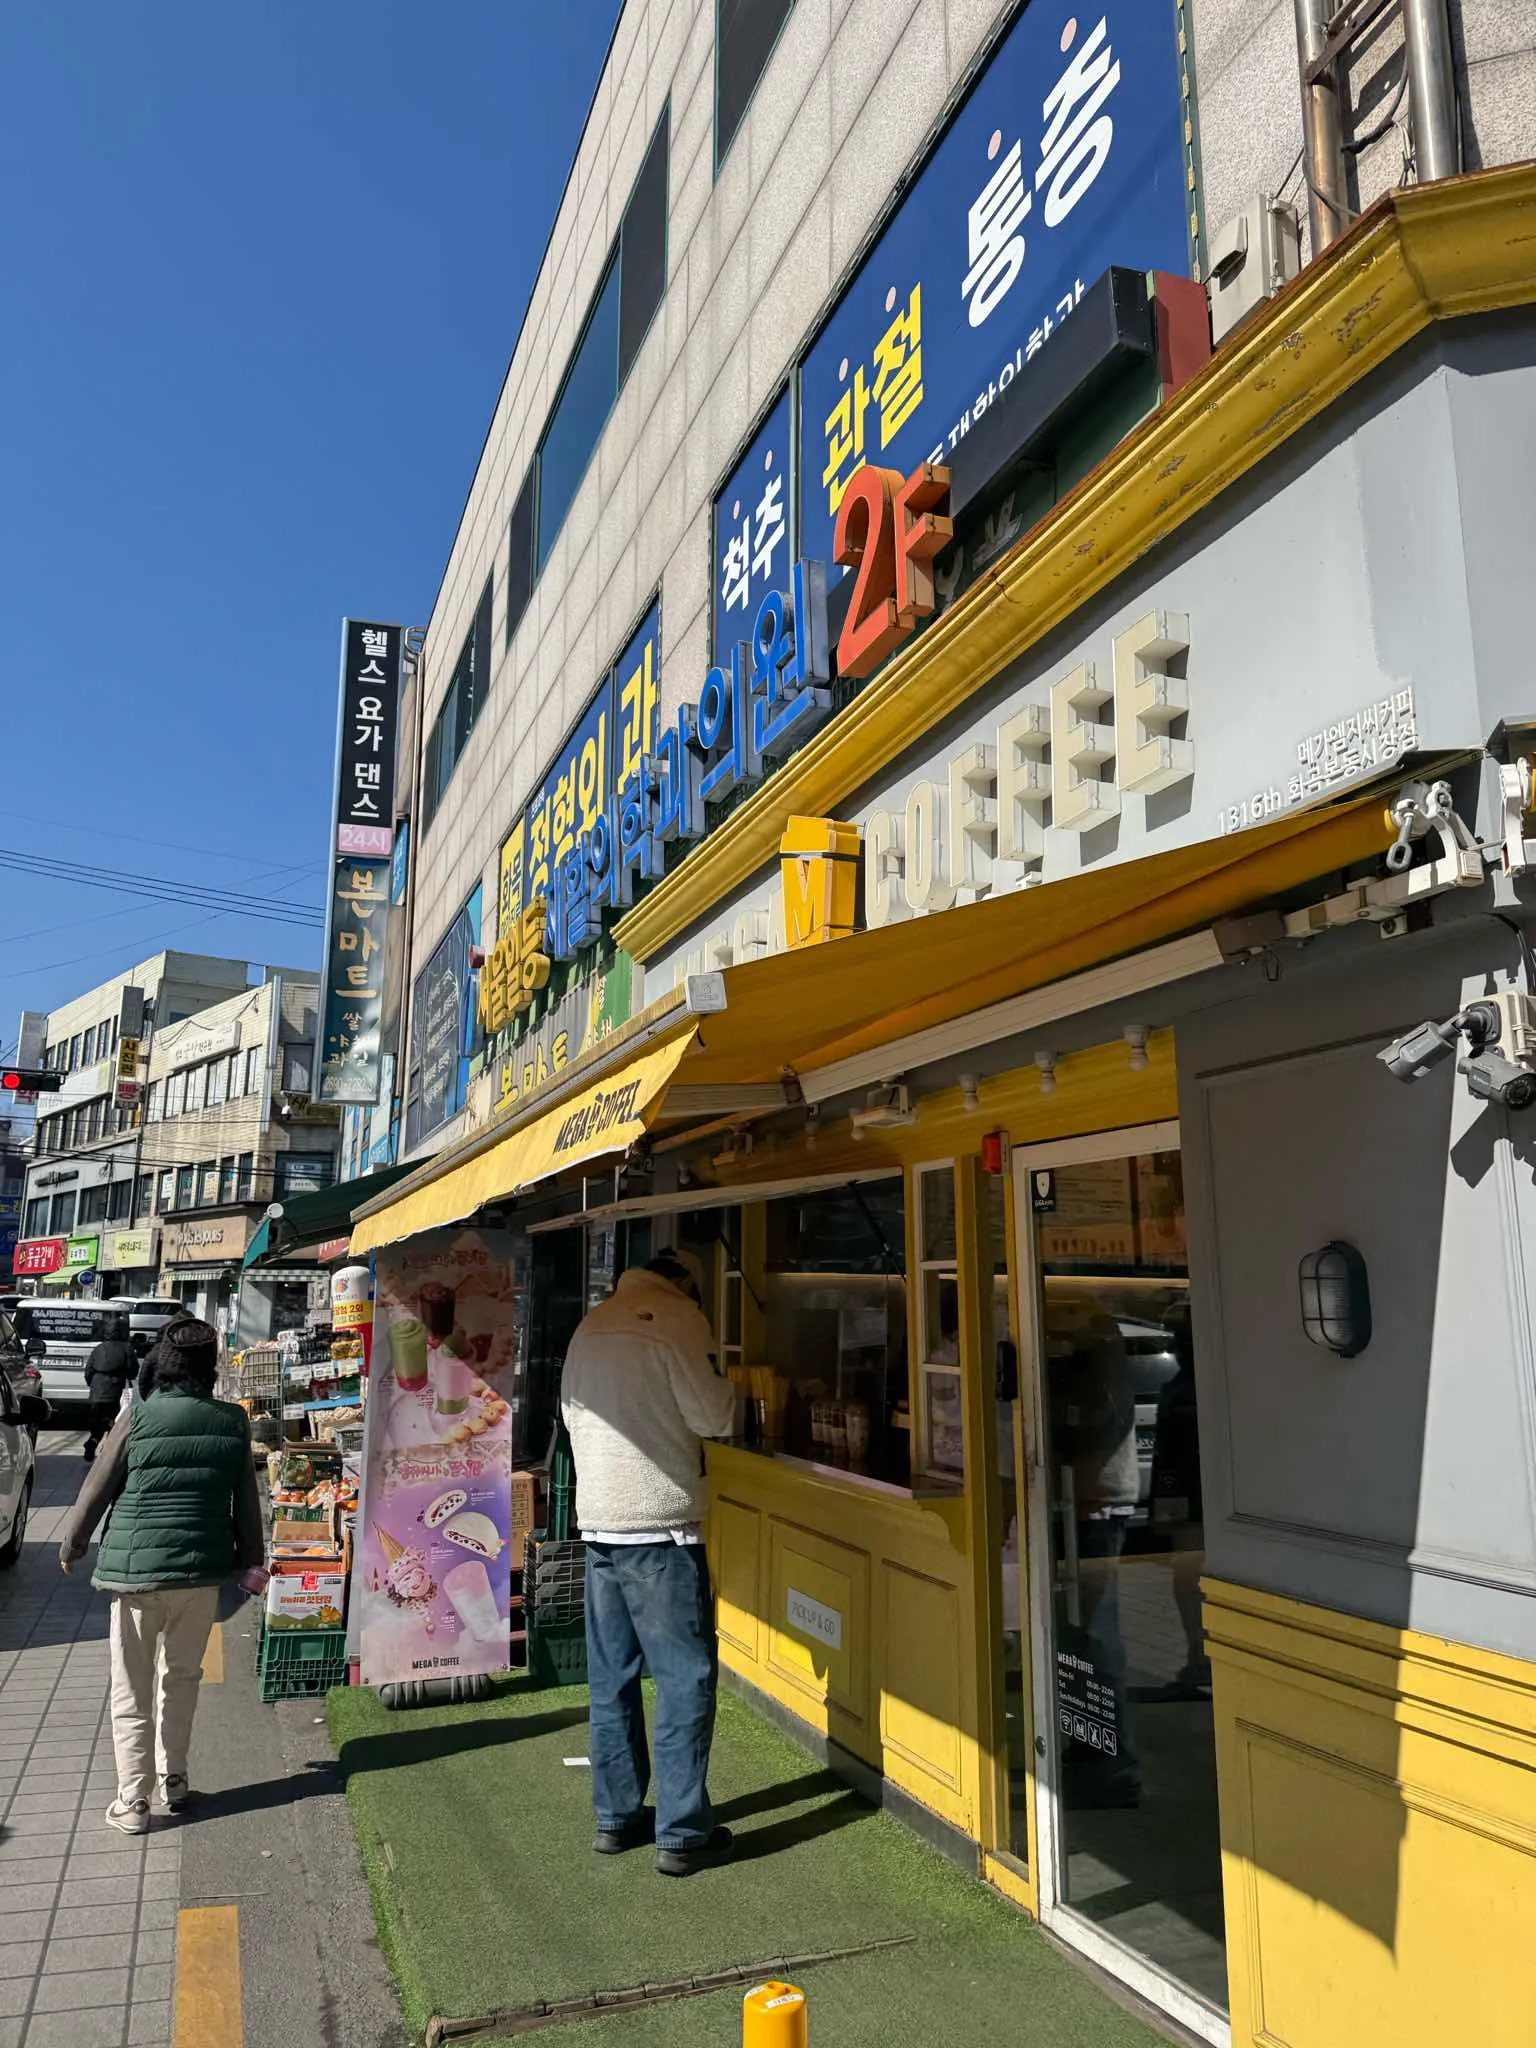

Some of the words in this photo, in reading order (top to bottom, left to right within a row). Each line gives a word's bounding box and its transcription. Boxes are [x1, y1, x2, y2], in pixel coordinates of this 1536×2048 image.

[721, 472, 787, 612] 척추
[822, 281, 924, 516] 관절
[962, 16, 1121, 328] 통증
[834, 463, 953, 678] 2F
[358, 629, 388, 684] 헬스
[354, 696, 384, 752] 요가
[1297, 686, 1416, 766] 메가엠지씨커피
[350, 762, 381, 818] 댄스
[864, 608, 1196, 929] COFFEE
[1217, 785, 1282, 834] 1316th
[341, 829, 386, 850] 24시
[335, 869, 387, 998] 본마트
[596, 1079, 642, 1130] COFFEE
[412, 1659, 433, 1670] MEGA
[439, 1656, 461, 1667] COFFEE
